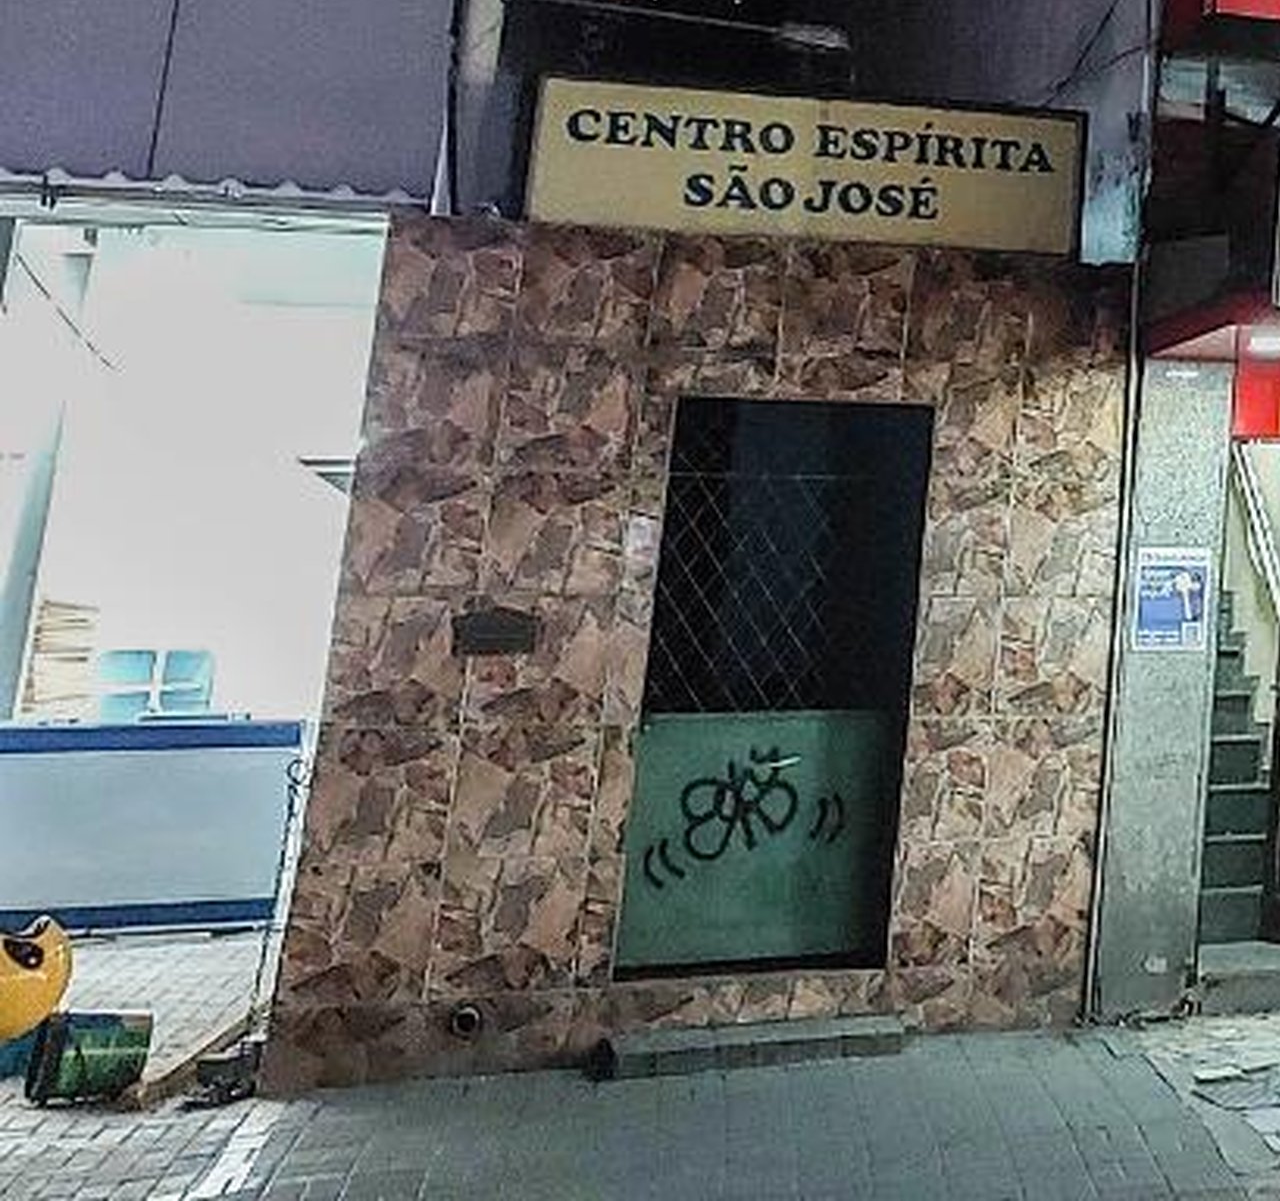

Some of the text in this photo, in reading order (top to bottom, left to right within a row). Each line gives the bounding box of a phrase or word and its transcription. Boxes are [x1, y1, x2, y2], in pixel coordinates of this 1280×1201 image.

[565, 109, 1057, 174] CENTRO ESPÍRITA
[683, 164, 939, 221] SÃO JOSÉ
